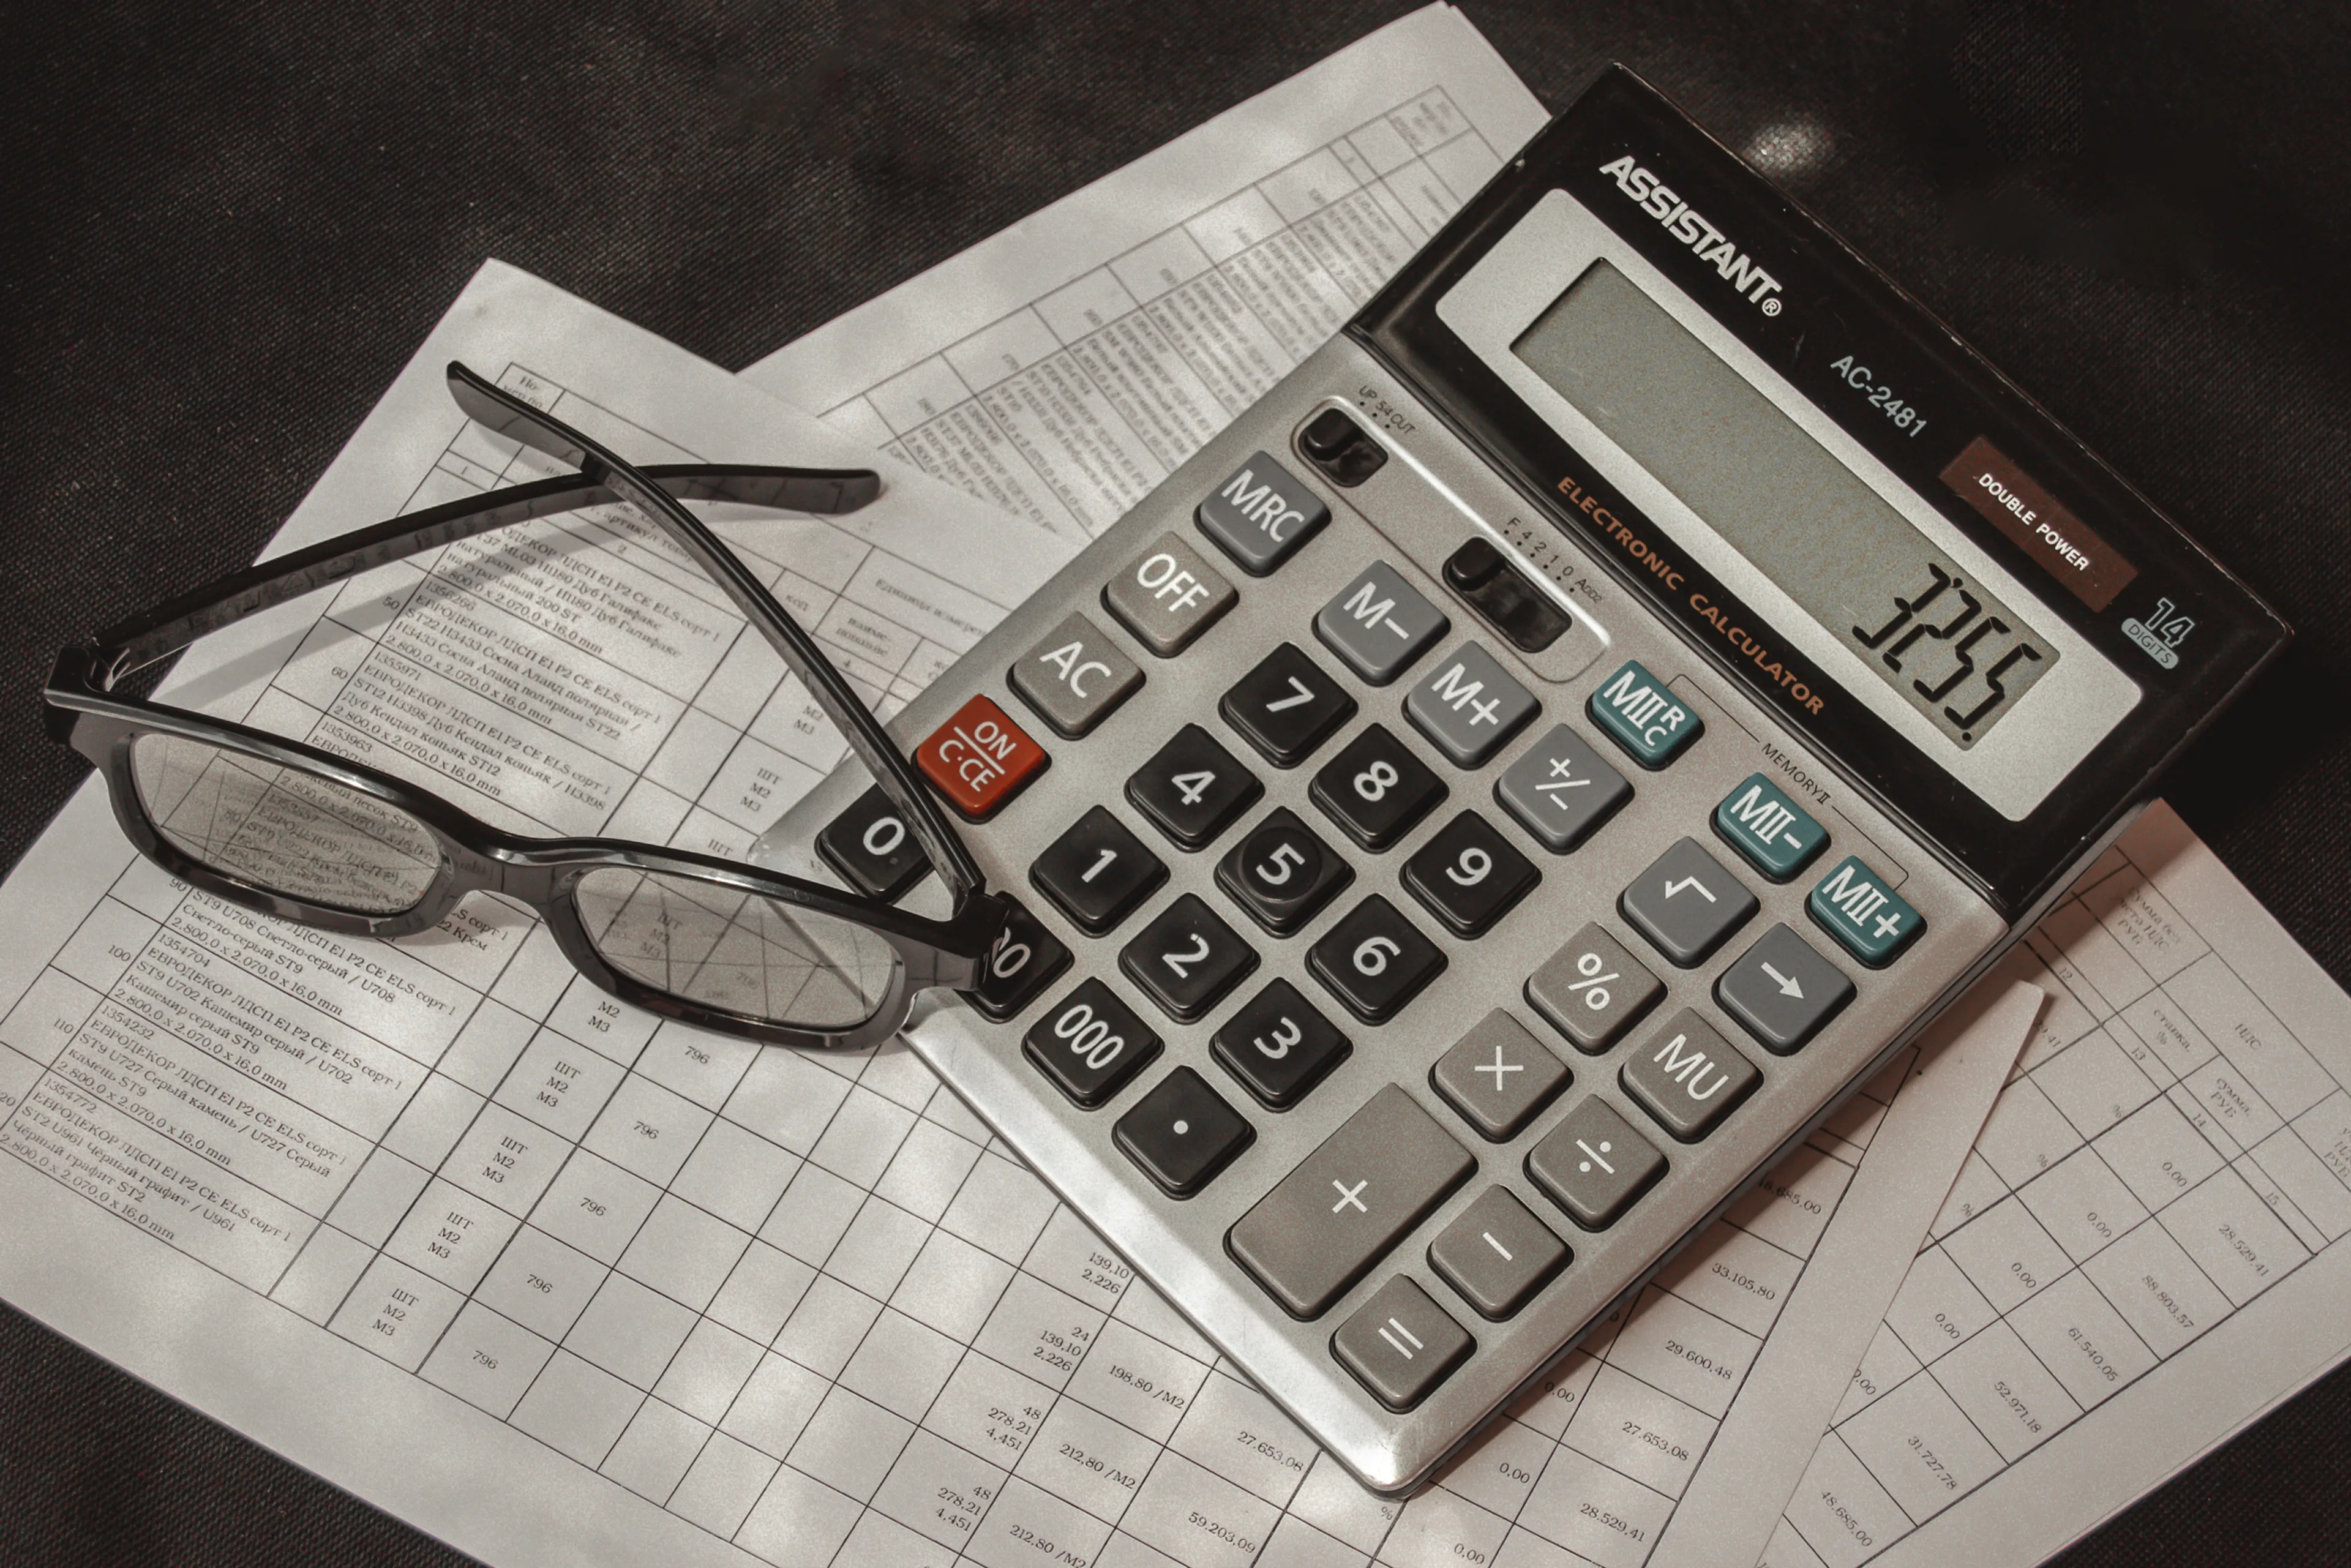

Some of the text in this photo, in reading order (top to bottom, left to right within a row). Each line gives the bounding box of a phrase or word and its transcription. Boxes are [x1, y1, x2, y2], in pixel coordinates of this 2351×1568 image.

[1831, 354, 1927, 438] AC-2481
[1390, 413, 1416, 434] CUT
[1221, 469, 1305, 542] MRC
[1979, 471, 2089, 572] DOUBLE POWER
[1507, 517, 1521, 527] F
[1522, 531, 1533, 540] 4
[1534, 542, 1547, 552] 2
[1550, 554, 1559, 564] 1
[1137, 553, 1209, 612] OFF
[1557, 476, 1824, 715] ELECTRONIC CALCULATOR
[382, 596, 400, 610] 50
[2144, 597, 2195, 648] 14
[2128, 623, 2173, 664] DIGITS
[331, 666, 349, 680] 60
[374, 651, 422, 681] 1355971
[1039, 641, 1112, 699] AC
[1266, 675, 1315, 713] 7
[1431, 662, 1501, 727] M+
[973, 720, 1018, 761] ON
[1171, 770, 1216, 805] 4
[1353, 760, 1399, 802] 8
[863, 816, 906, 856] 0
[1081, 849, 1117, 883] 1
[1255, 842, 1306, 886] 5
[1444, 847, 1494, 887] 9
[192, 891, 221, 910] ST9
[107, 944, 132, 962] 100
[158, 934, 211, 968] 1354704
[1162, 934, 1210, 979] 2
[1352, 935, 1401, 977] 6
[1567, 952, 1621, 1011] %
[136, 961, 165, 981] ST9
[166, 976, 200, 1002] U702
[318, 1059, 353, 1085] U702
[1054, 1003, 1125, 1070] 000
[1253, 1016, 1303, 1060] 3
[554, 1060, 581, 1079] ШТ
[684, 1045, 710, 1065] 796
[1653, 1033, 1730, 1101] MU
[44, 1078, 97, 1114] 1354772
[108, 1049, 144, 1073] U727
[250, 1129, 287, 1152] U727
[118, 1076, 148, 1097] ST9
[634, 1120, 659, 1139] 796
[116, 1181, 146, 1203] ST2
[580, 1197, 607, 1217] 796
[527, 1274, 553, 1294] 796
[1071, 1327, 1089, 1342] 24
[473, 1349, 498, 1370] 796
[1023, 1406, 1041, 1420] 48
[973, 1486, 992, 1500] 48
